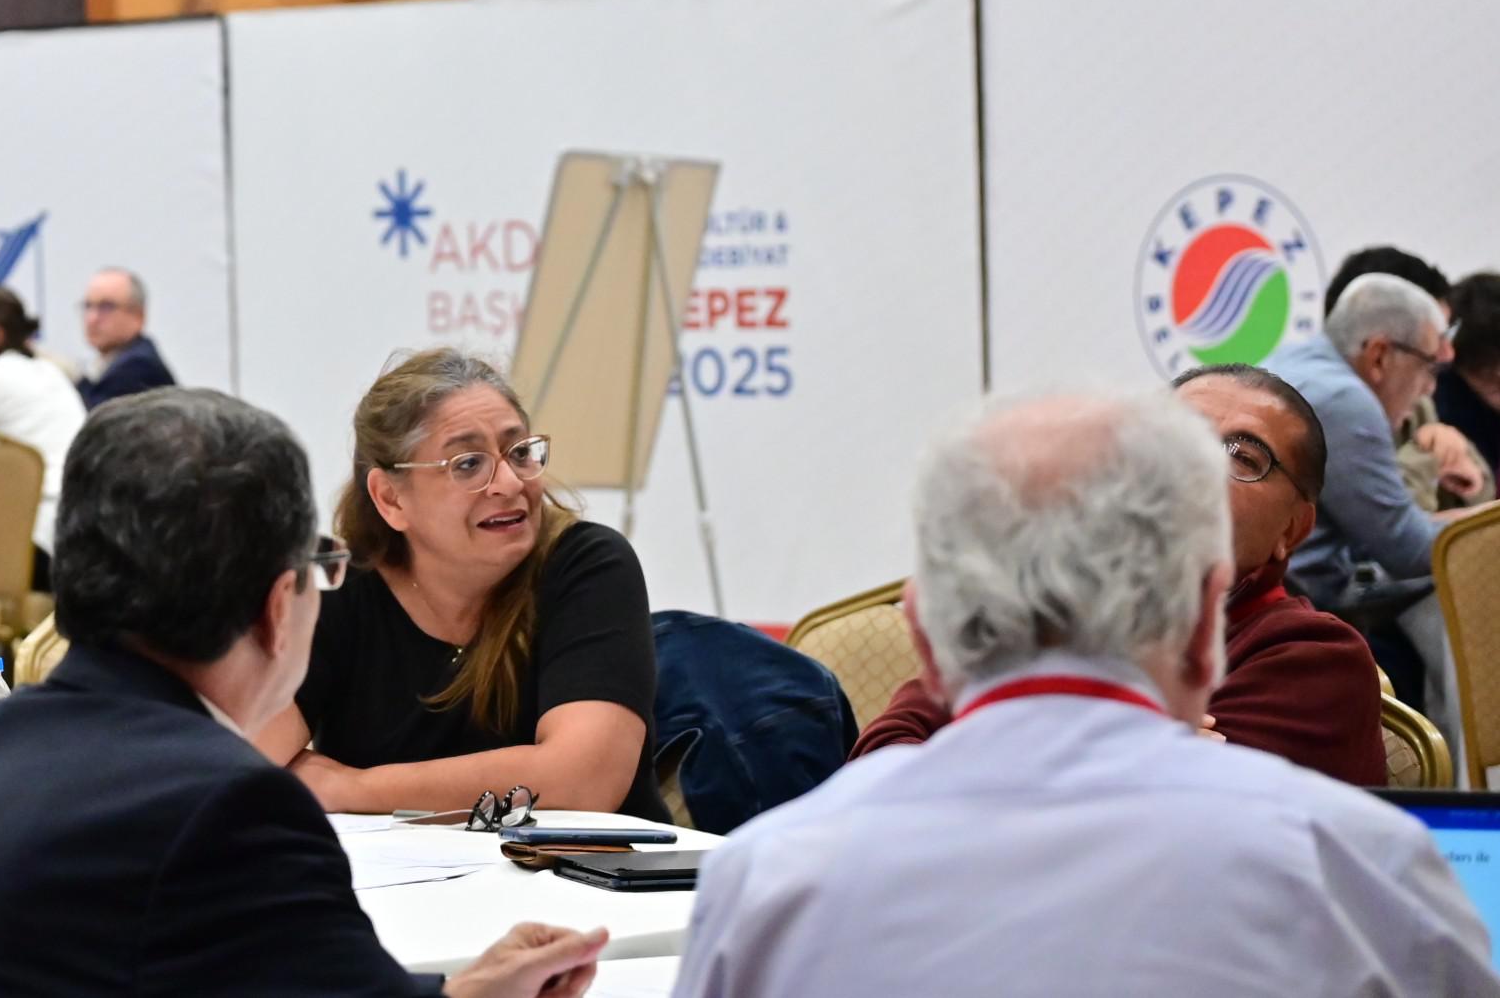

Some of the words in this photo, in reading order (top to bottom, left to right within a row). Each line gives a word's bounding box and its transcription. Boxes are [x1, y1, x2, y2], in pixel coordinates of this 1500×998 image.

[429, 219, 542, 272] AKD
[1151, 187, 1307, 269] KEPEZ
[682, 288, 789, 329] EPEZ
